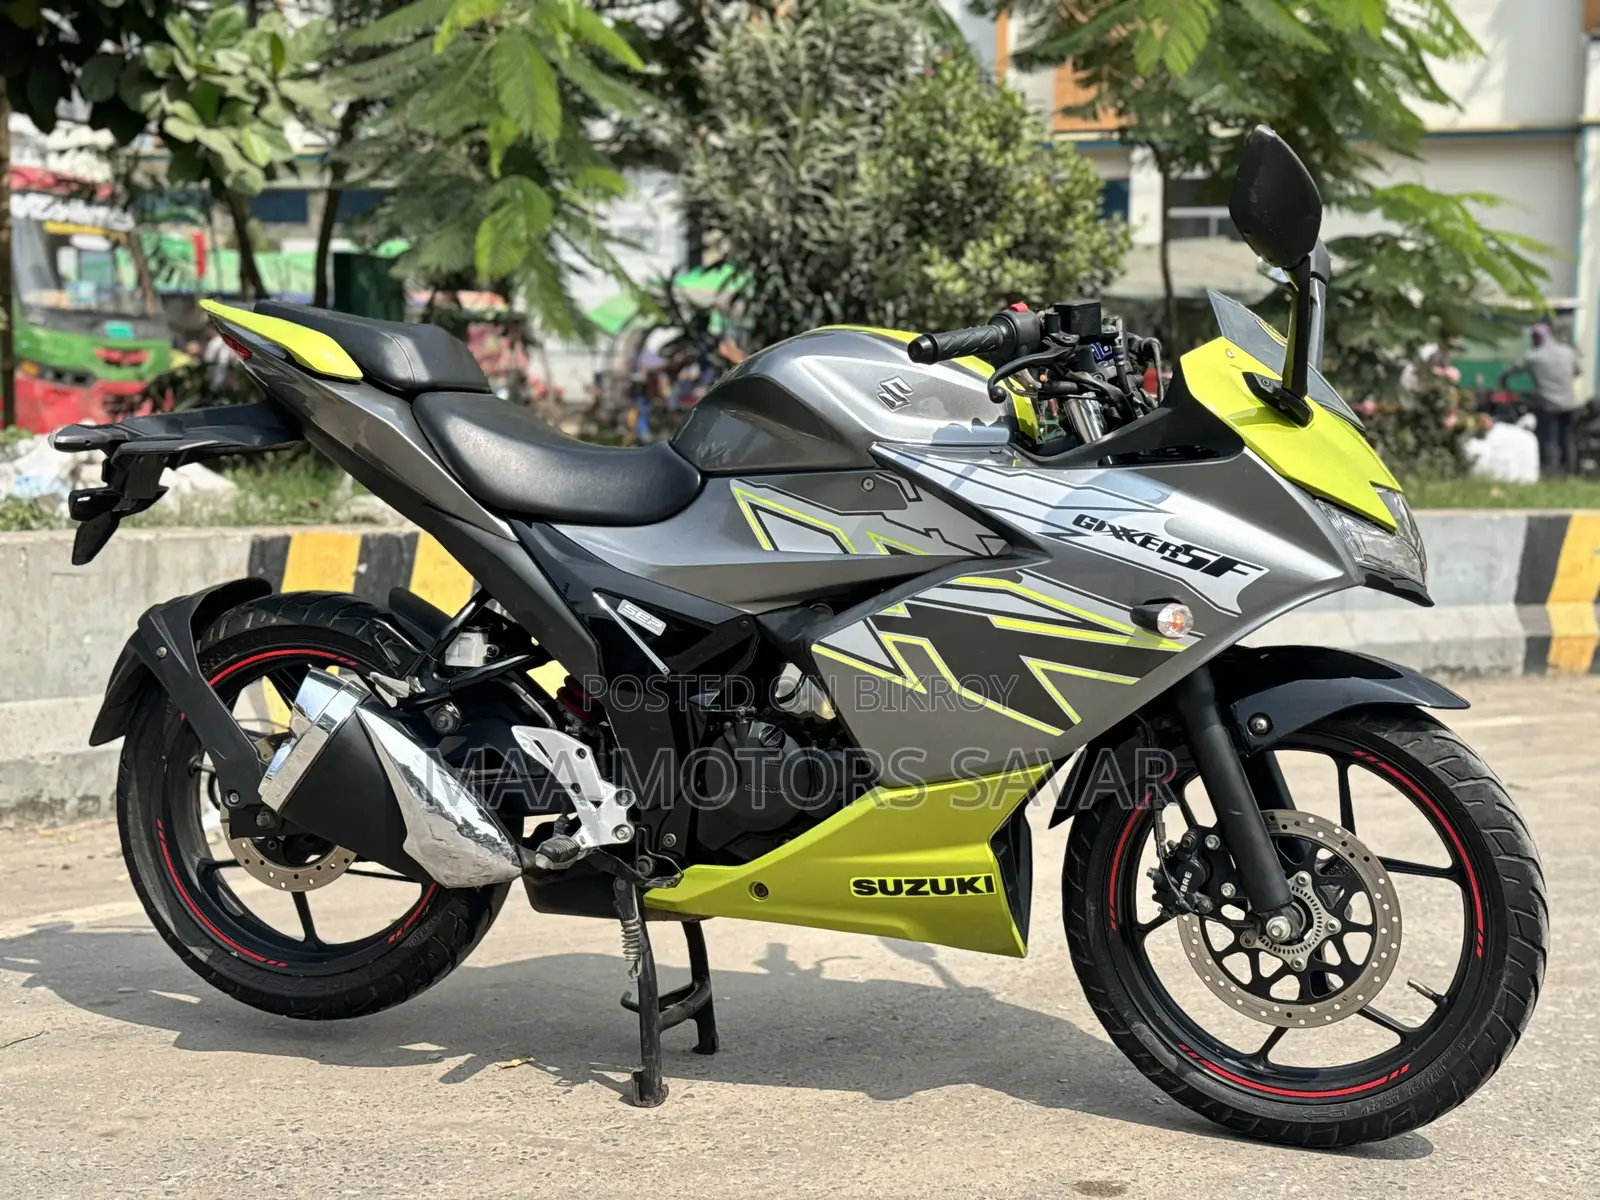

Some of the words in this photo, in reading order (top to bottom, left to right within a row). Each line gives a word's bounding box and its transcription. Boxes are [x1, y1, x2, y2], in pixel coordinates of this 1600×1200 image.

[1072, 513, 1184, 560] GIXXER
[1160, 543, 1264, 578] SF
[622, 603, 663, 628] SEP
[852, 875, 995, 896] SUZUKI
